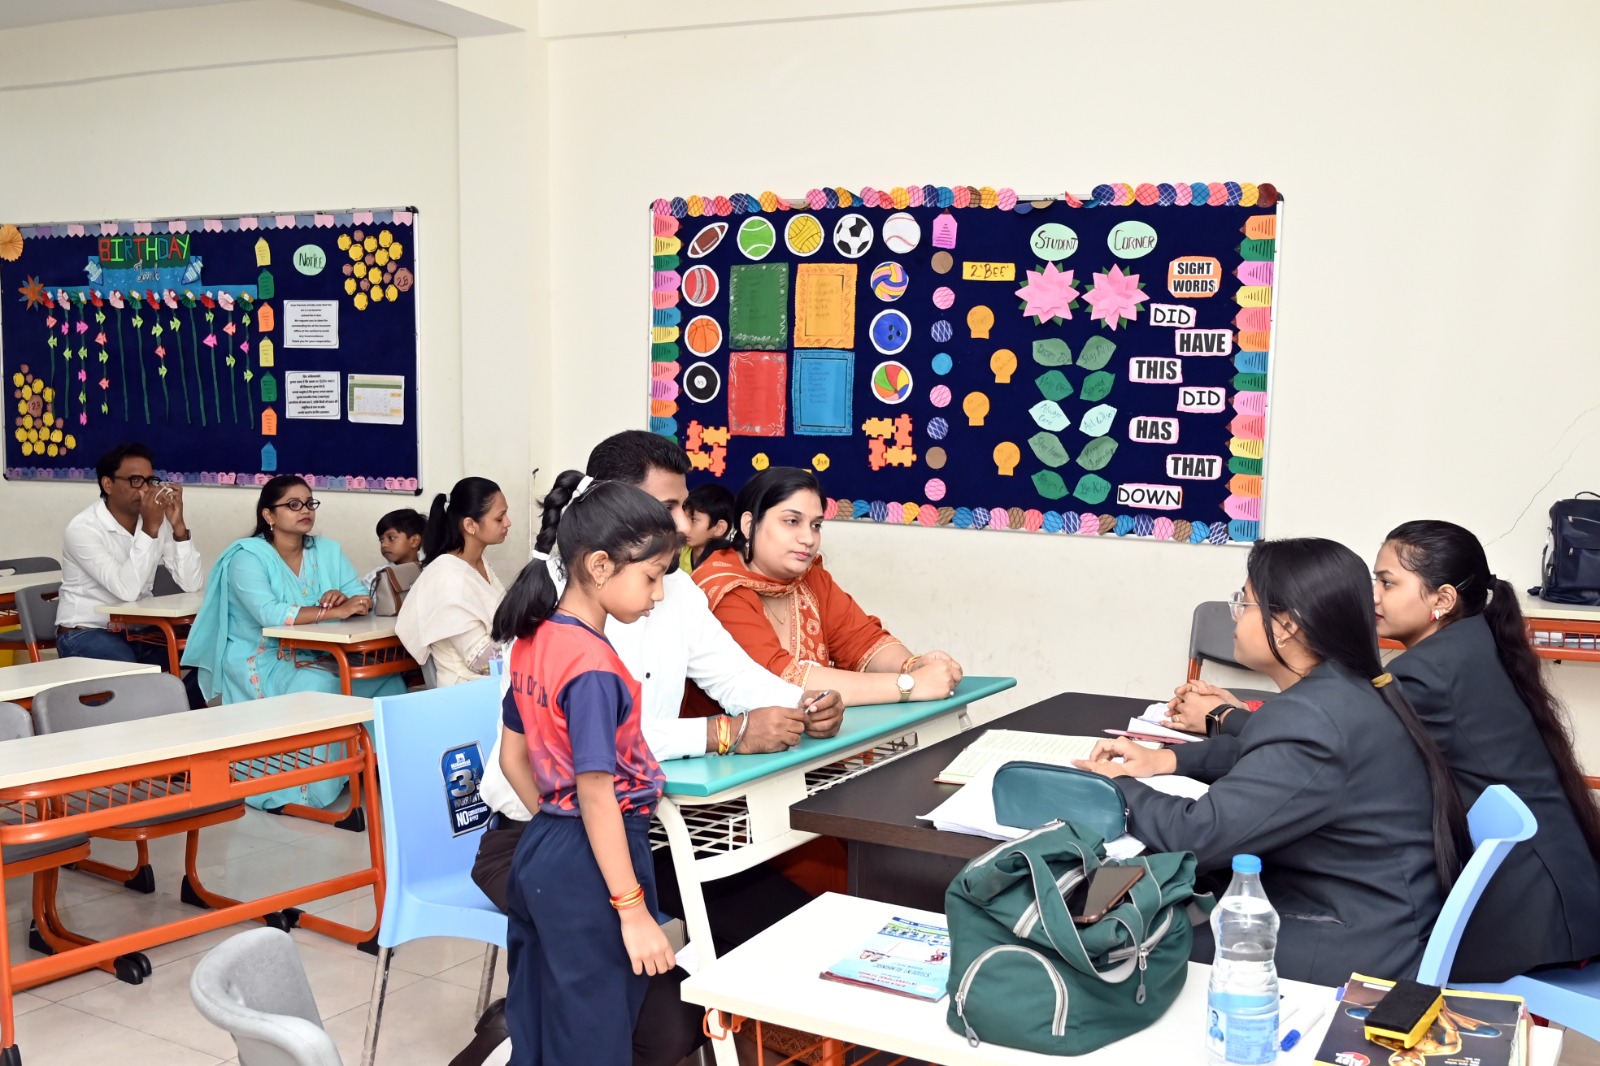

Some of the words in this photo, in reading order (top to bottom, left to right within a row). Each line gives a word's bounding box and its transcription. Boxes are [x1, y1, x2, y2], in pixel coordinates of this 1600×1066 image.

[99, 234, 190, 262] BIRTHDAY
[1177, 262, 1212, 275] SIGHT
[1173, 279, 1216, 293] WORDS
[1153, 308, 1191, 325] DID
[1179, 333, 1226, 353] HAVE
[1135, 360, 1178, 380] THIS
[1183, 390, 1221, 407] DID
[1136, 421, 1172, 441] HAS
[1171, 457, 1217, 478] THAT
[1118, 487, 1181, 506] DOWN
[450, 769, 476, 798] 3
[456, 810, 469, 828] NO
